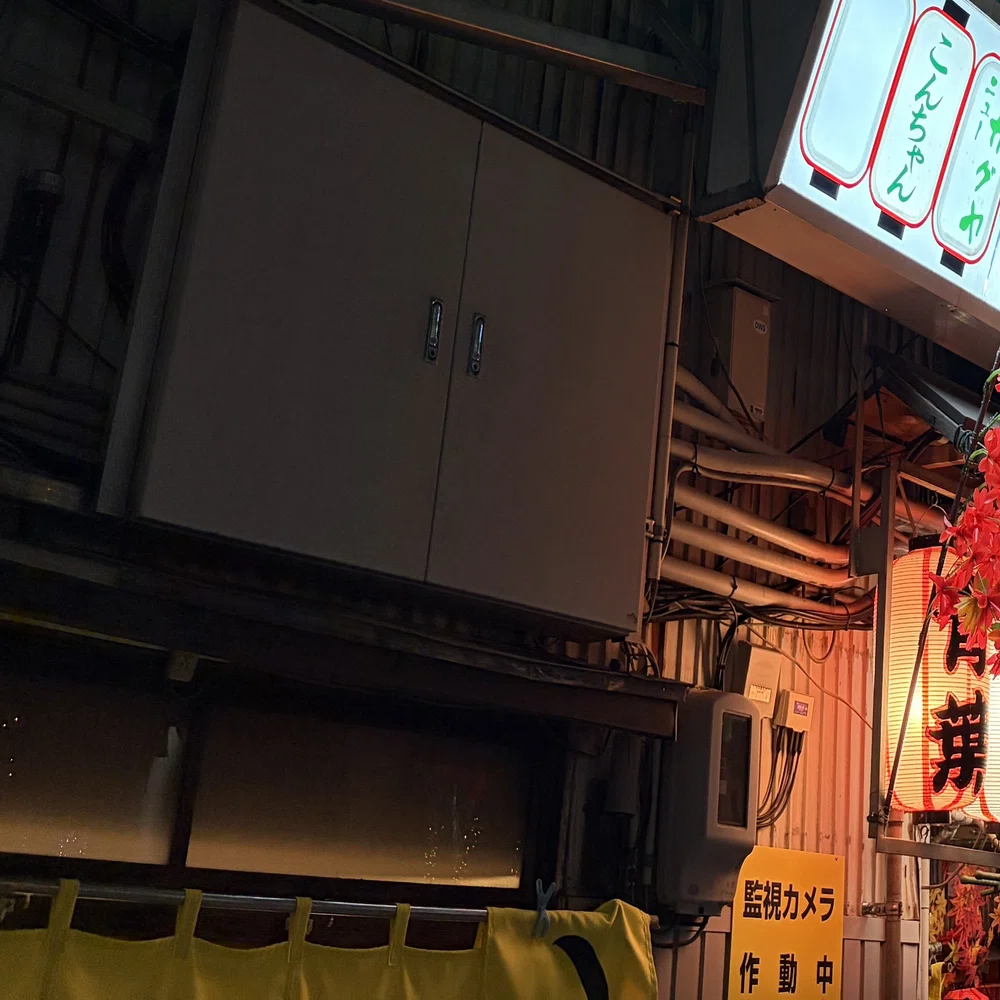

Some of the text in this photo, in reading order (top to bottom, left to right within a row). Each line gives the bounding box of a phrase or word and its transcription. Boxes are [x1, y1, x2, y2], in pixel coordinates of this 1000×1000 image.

[886, 32, 953, 203] こんちゃん
[743, 880, 835, 922] 監視カメラ
[739, 952, 834, 995] 作動中
